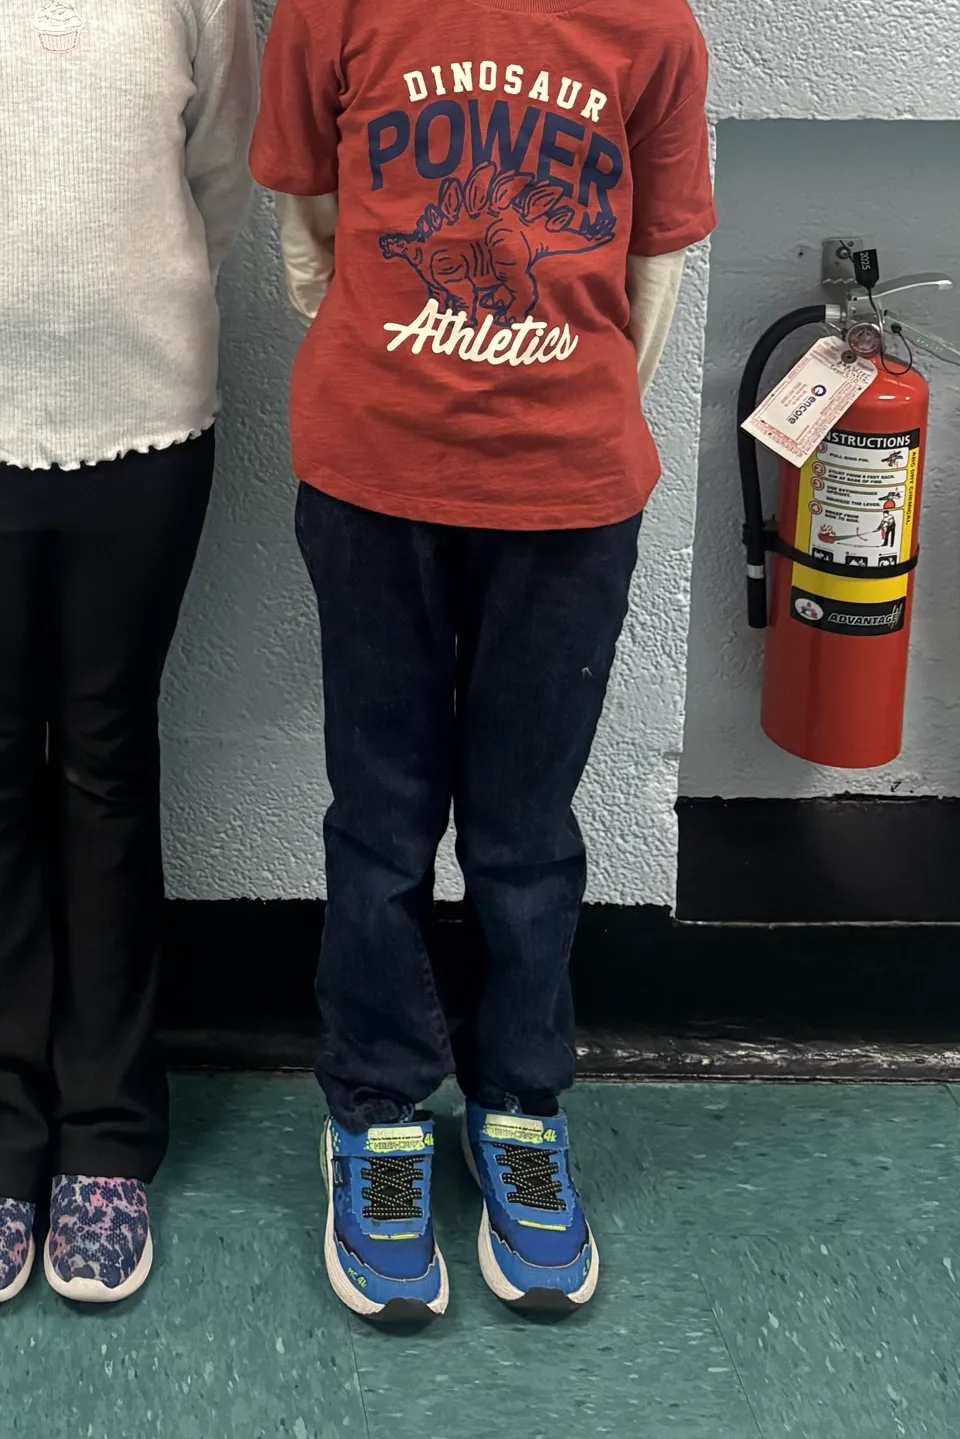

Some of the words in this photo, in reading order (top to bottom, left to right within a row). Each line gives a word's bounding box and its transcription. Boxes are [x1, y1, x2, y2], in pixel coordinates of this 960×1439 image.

[403, 60, 608, 123] DINOSAUR
[367, 99, 624, 221] POWER
[860, 251, 871, 270] 2025
[384, 298, 579, 366] Athletics
[788, 396, 816, 424] encore
[825, 432, 911, 448] NSTRUCTIONS
[827, 612, 897, 627] ADVANTAGE
